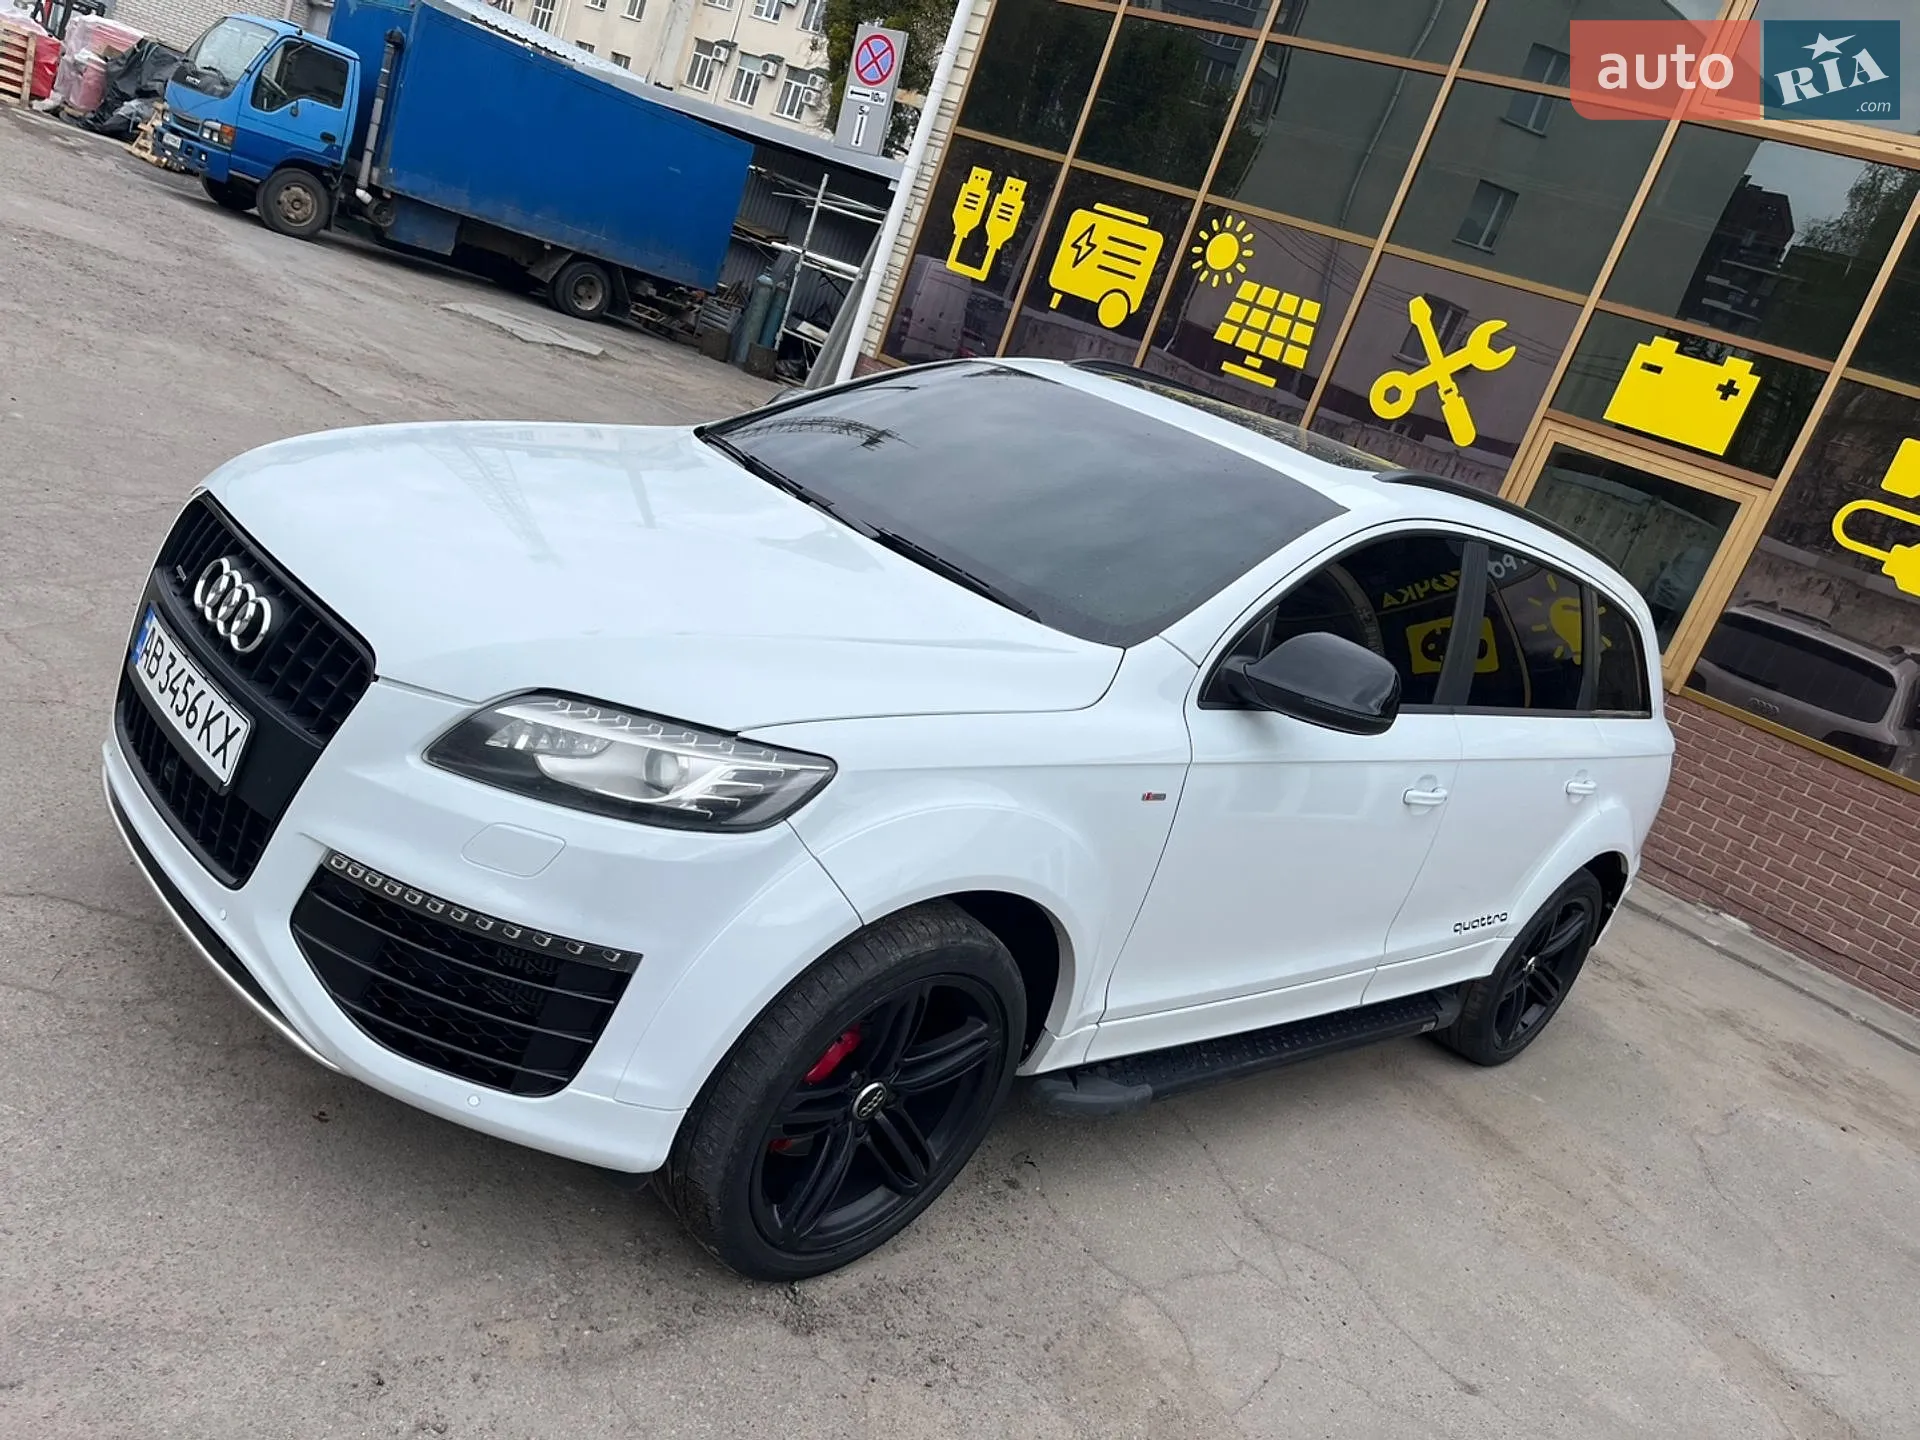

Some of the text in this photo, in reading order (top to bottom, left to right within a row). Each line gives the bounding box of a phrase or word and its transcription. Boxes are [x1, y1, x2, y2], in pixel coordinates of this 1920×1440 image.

[142, 627, 241, 770] AB 3456 KX
[1453, 911, 1508, 935] quattro
